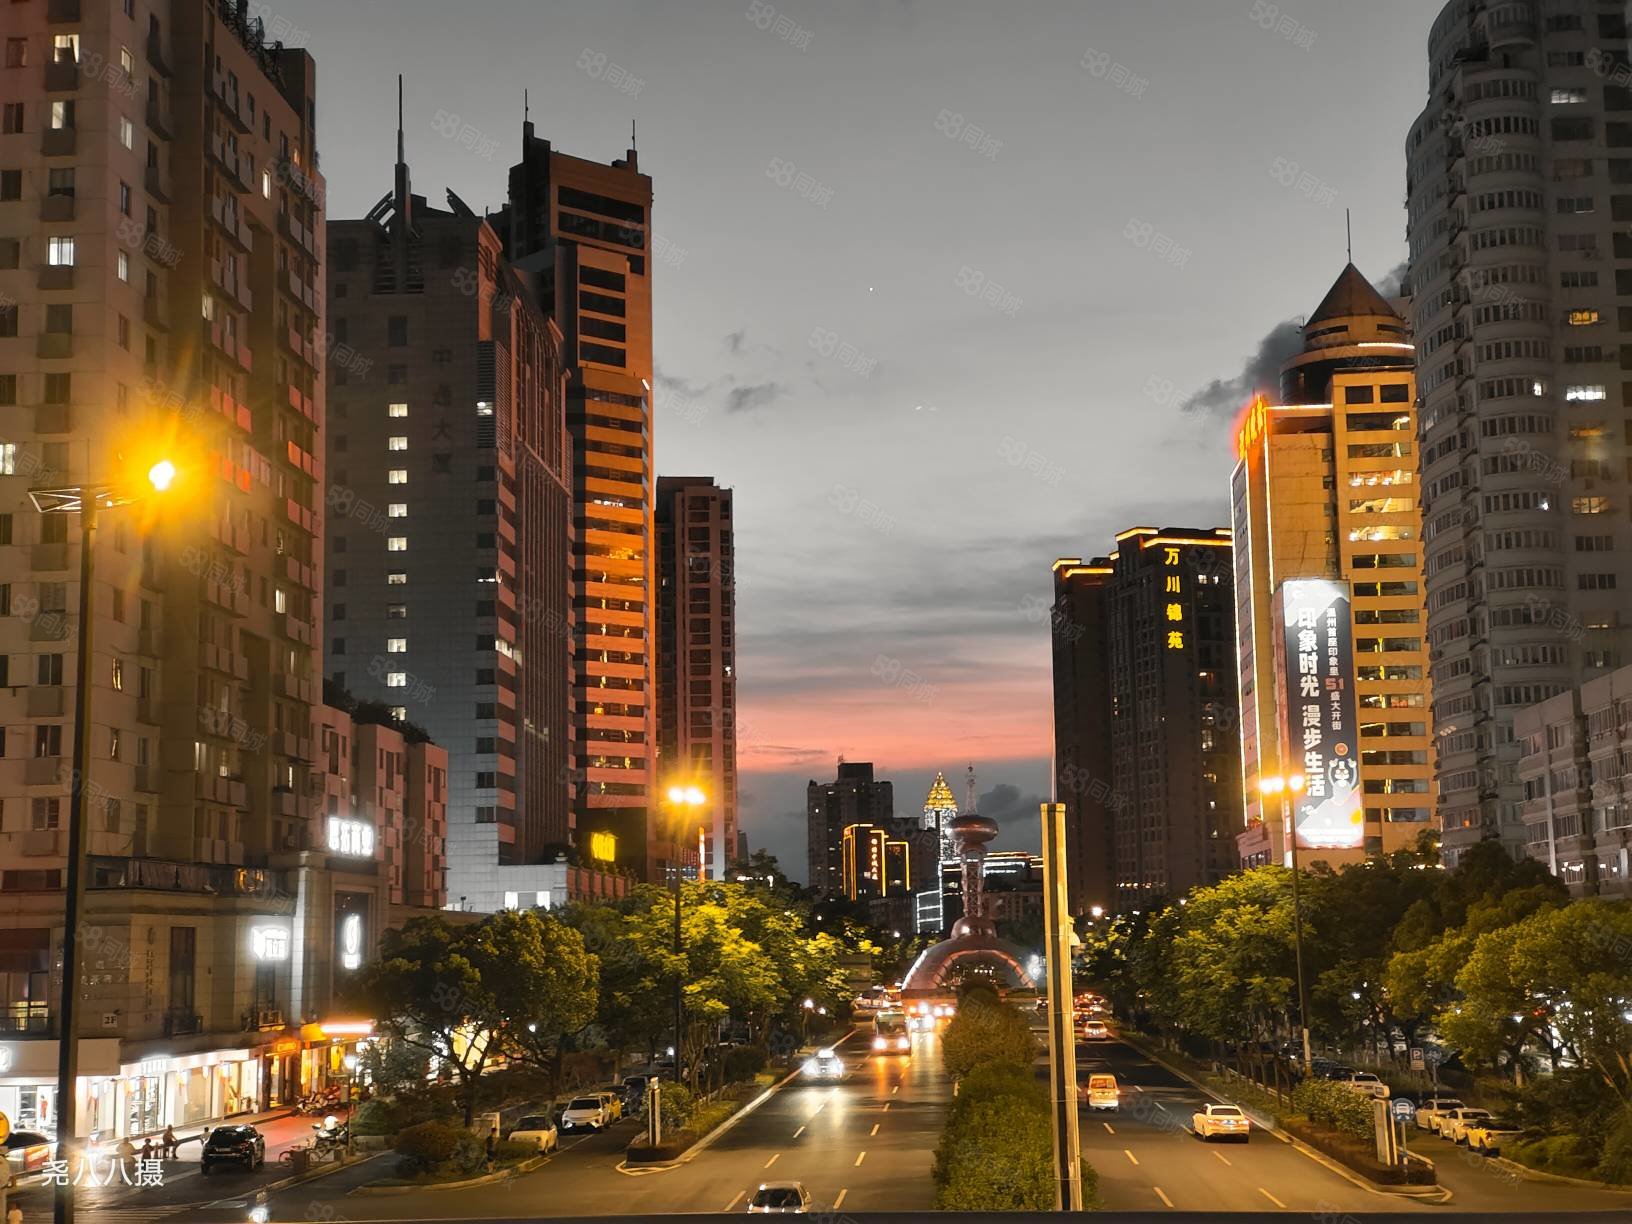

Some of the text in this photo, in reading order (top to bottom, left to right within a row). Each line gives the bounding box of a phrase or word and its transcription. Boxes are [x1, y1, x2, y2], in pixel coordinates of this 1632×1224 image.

[1163, 548, 1184, 649] 万川锦苑
[1298, 608, 1325, 797] 印象时光 漫步生活
[1413, 1050, 1421, 1059] P
